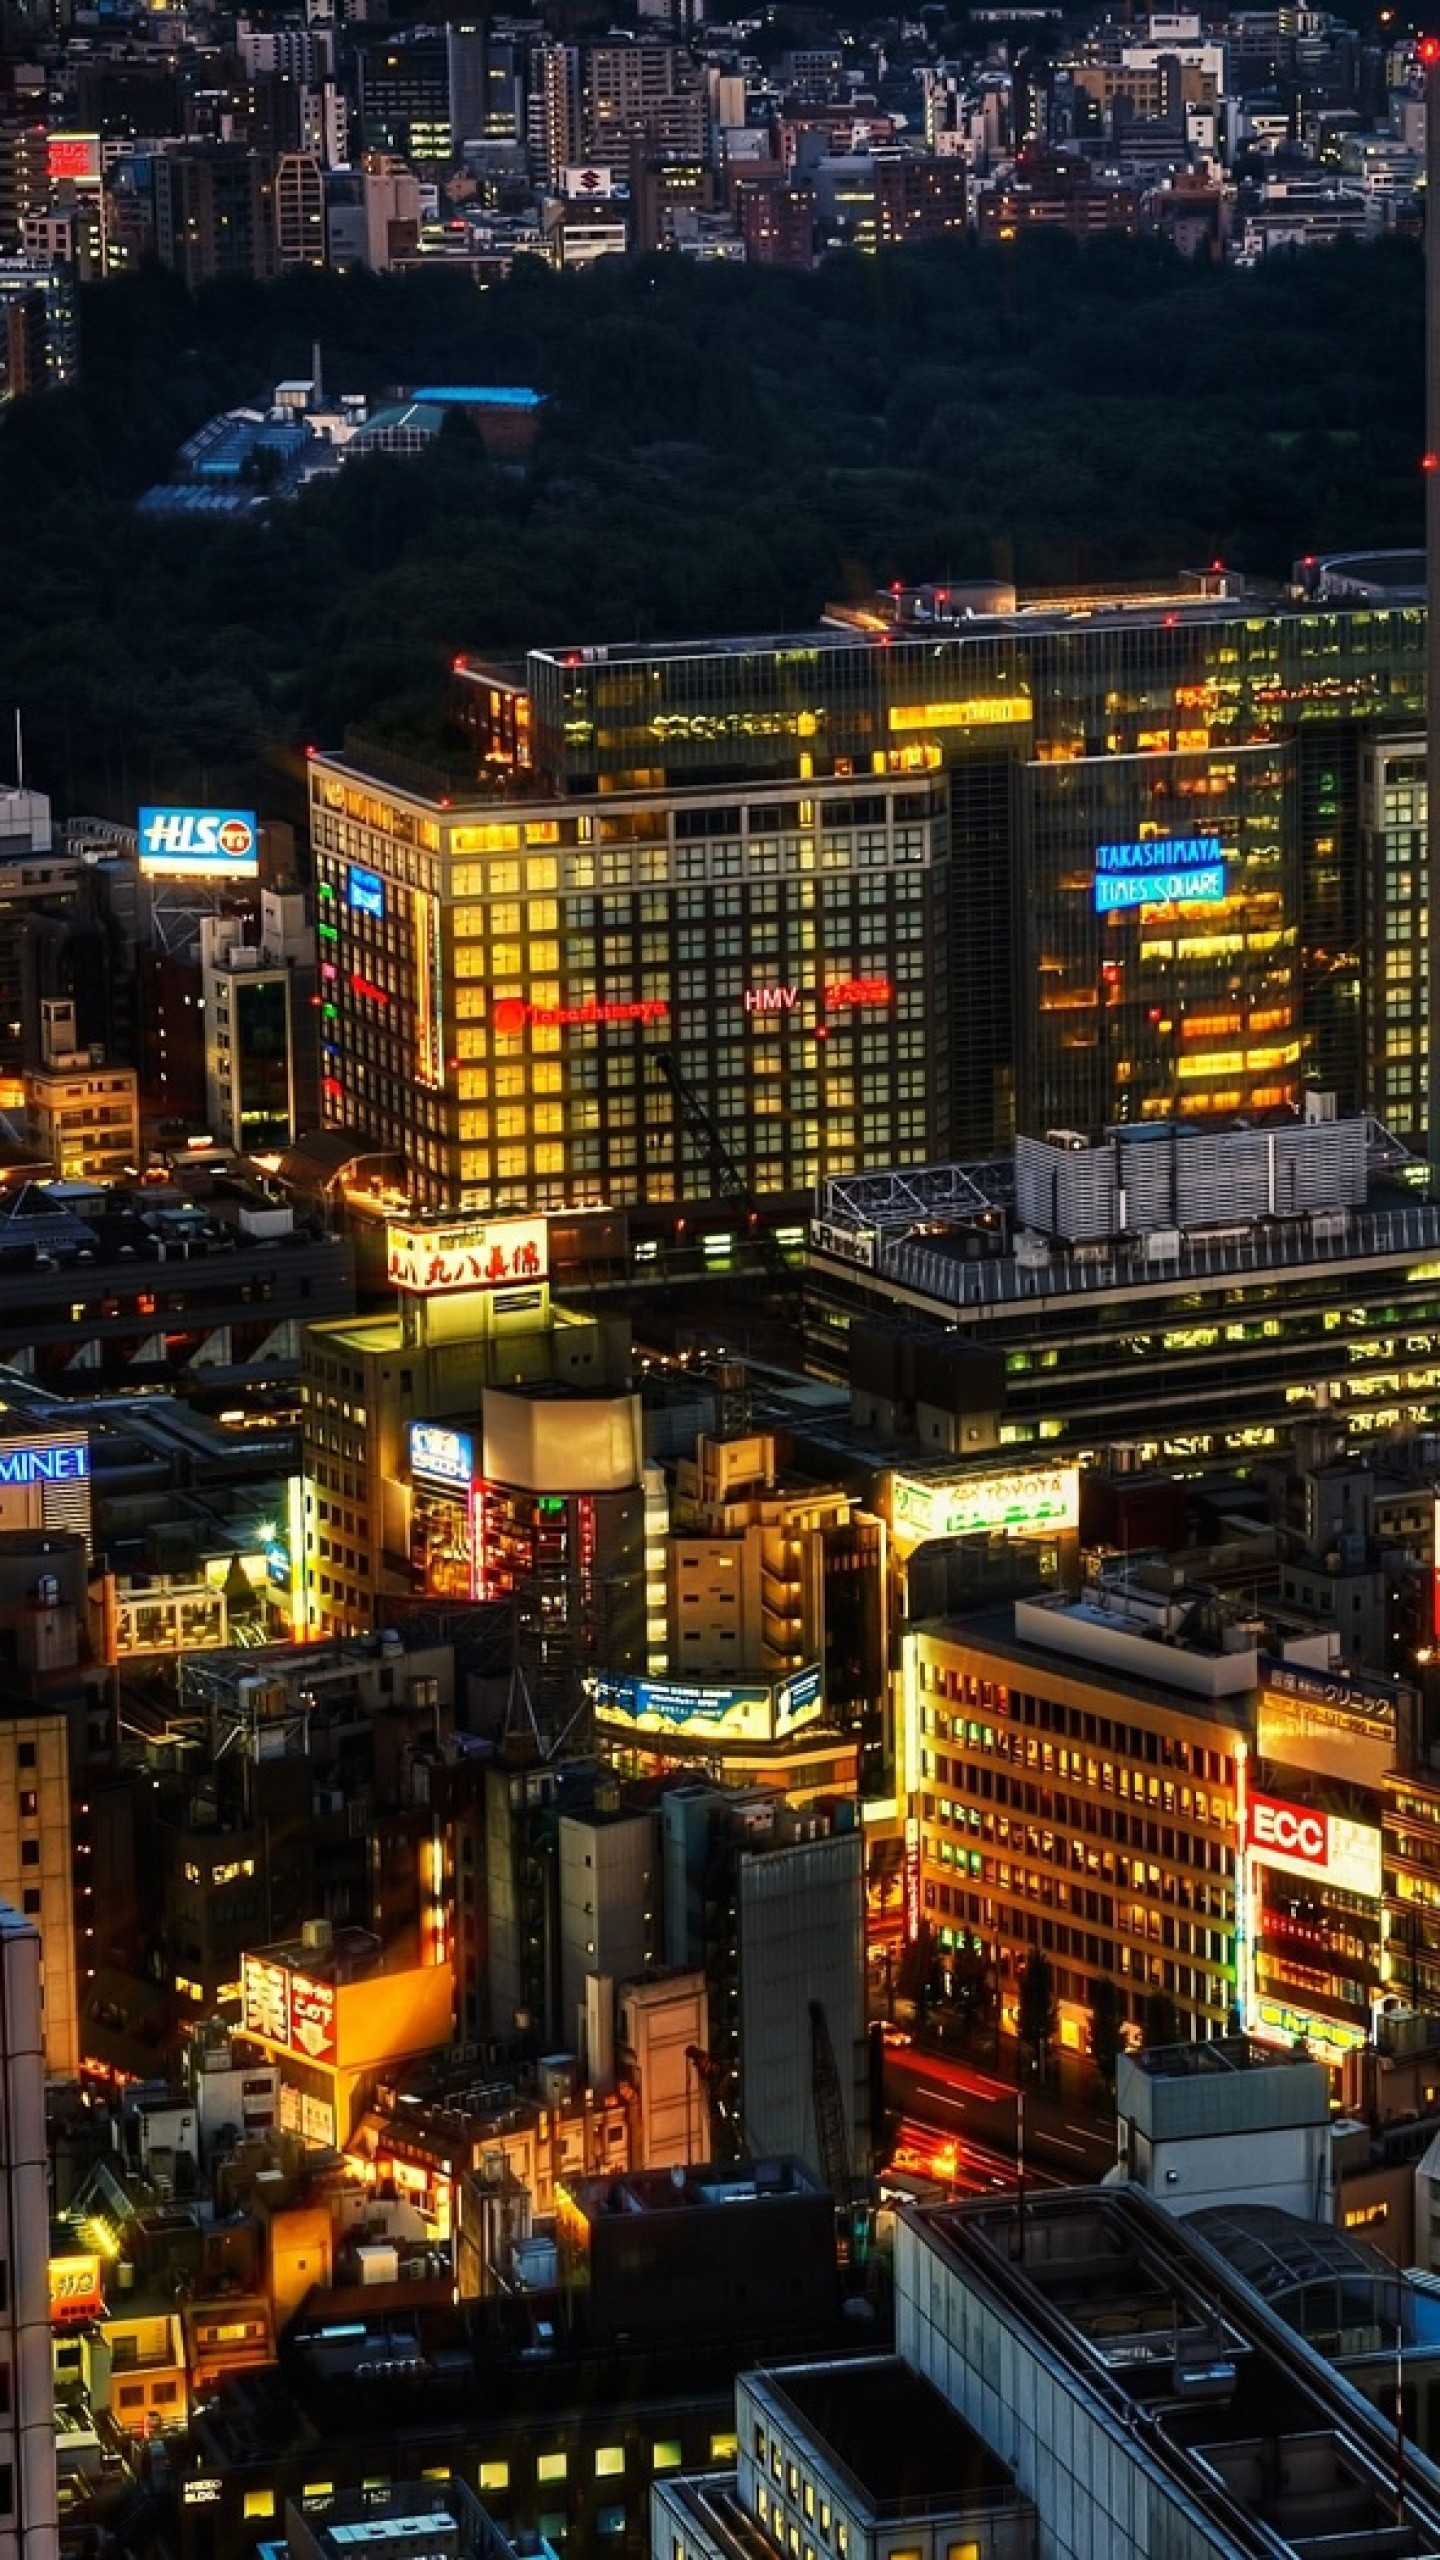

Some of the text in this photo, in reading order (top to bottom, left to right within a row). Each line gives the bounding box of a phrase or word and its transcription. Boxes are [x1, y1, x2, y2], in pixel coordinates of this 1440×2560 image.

[1097, 838, 1221, 869] TAKASHIMAYA
[1100, 872, 1219, 903] TIMES SQUARE
[527, 994, 668, 1026] Takashimaya
[745, 986, 797, 1012] HMV
[985, 1474, 1063, 1499] TOYOTA
[1254, 1804, 1324, 1856] ECC
